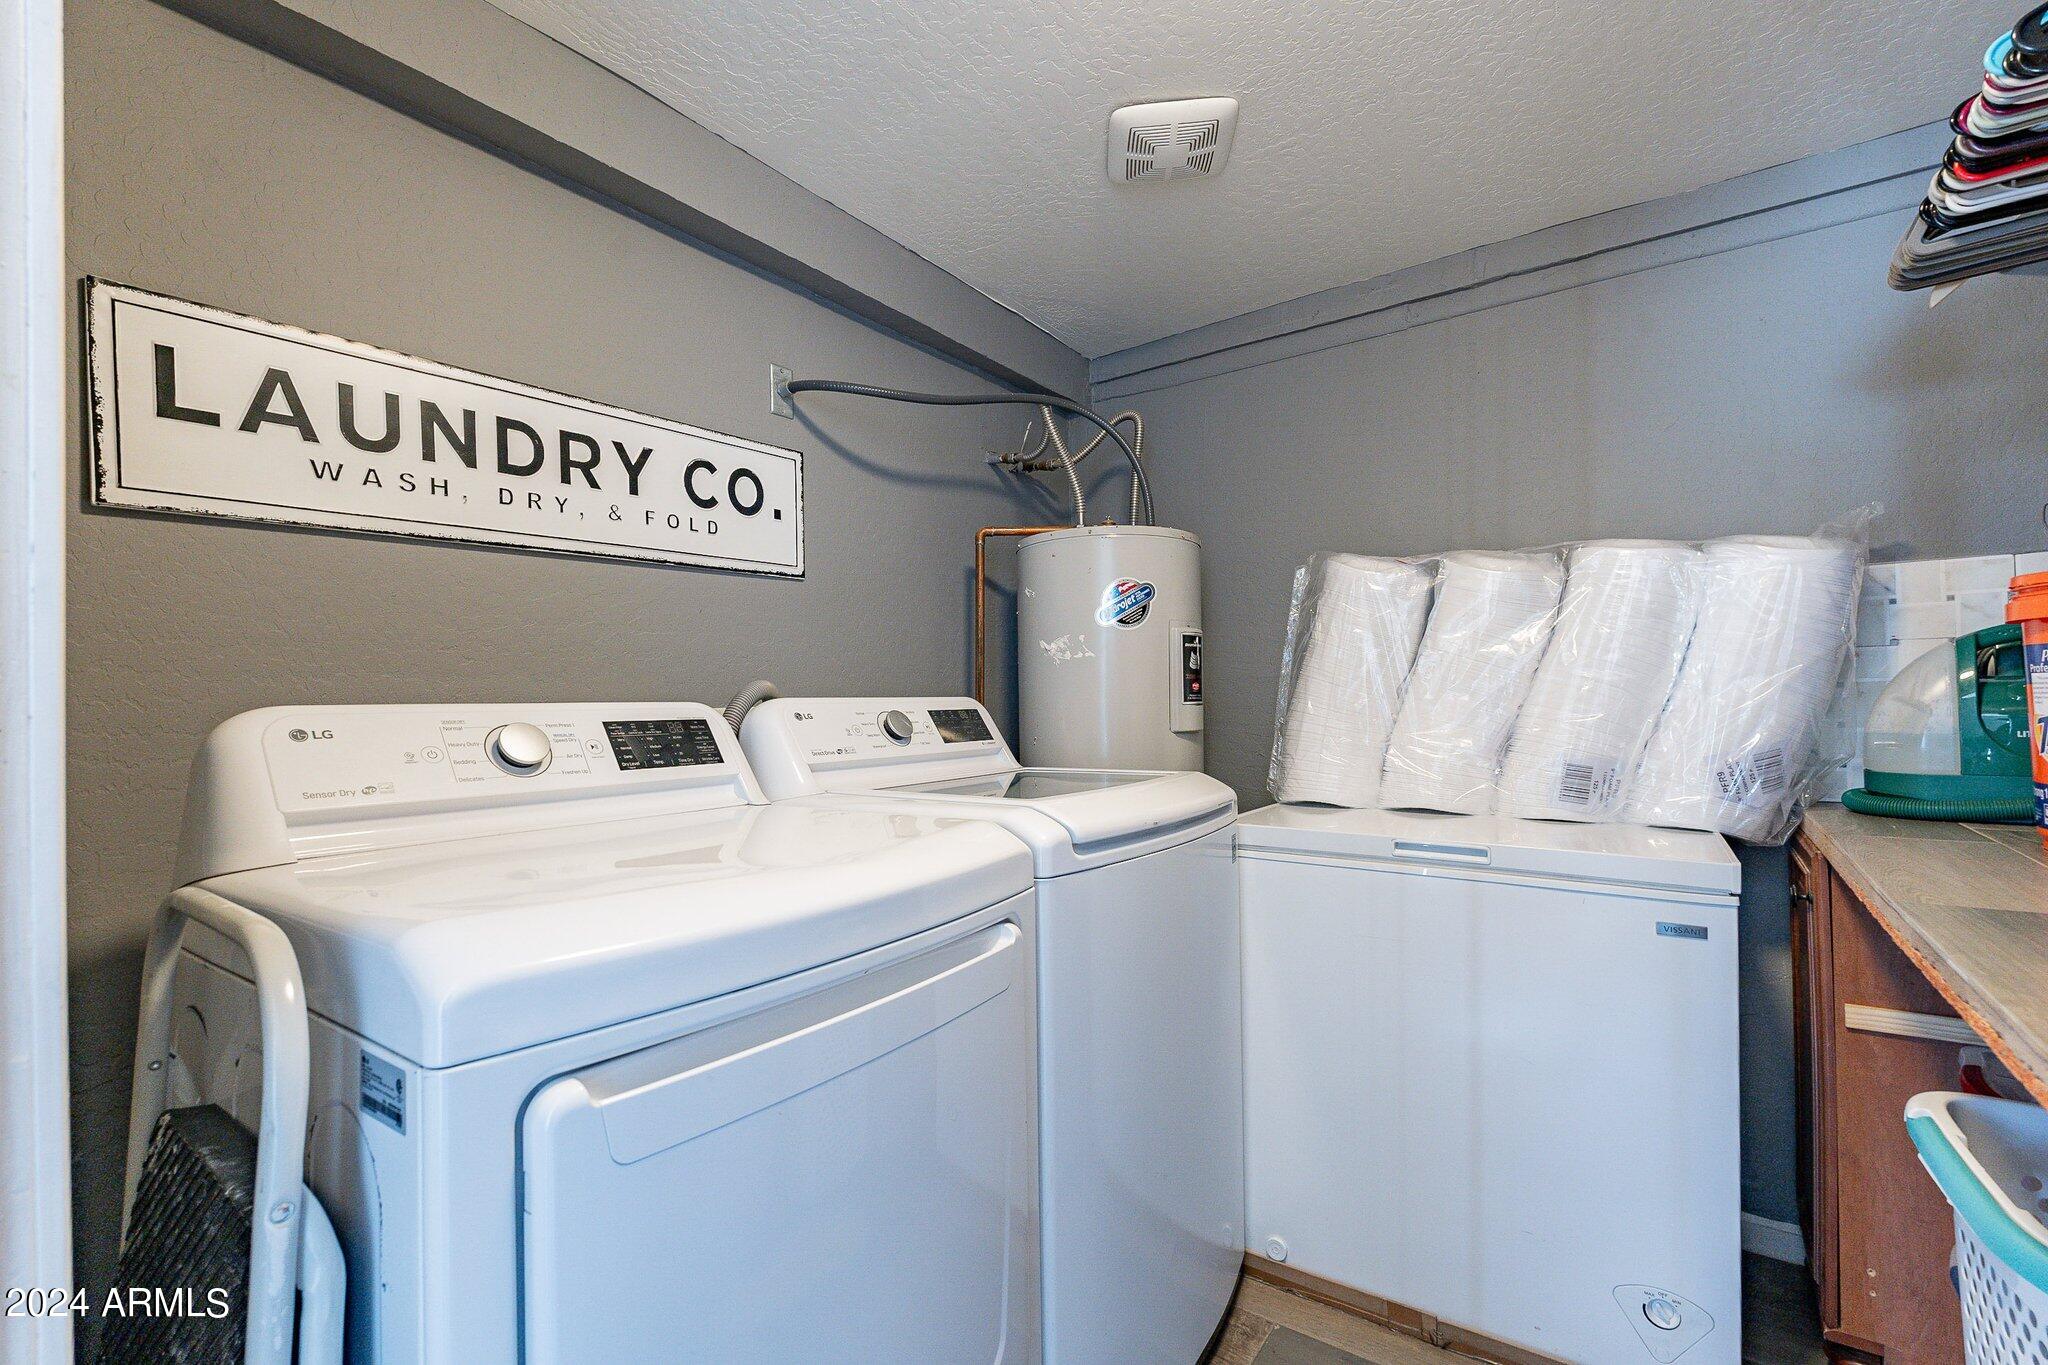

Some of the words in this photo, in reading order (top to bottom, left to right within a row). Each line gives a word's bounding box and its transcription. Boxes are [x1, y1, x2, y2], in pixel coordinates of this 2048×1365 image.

[153, 342, 653, 496] LAUNDRY
[683, 458, 783, 521] CO.
[309, 459, 469, 504] WASH,
[500, 487, 585, 521] DRY,
[608, 505, 622, 522] &
[645, 510, 720, 536] FOLD
[312, 730, 334, 740] LG
[1716, 771, 1730, 794] PFR9
[302, 790, 336, 800] Sensor
[339, 789, 356, 798] Dry
[1663, 925, 1701, 936] VISSANI
